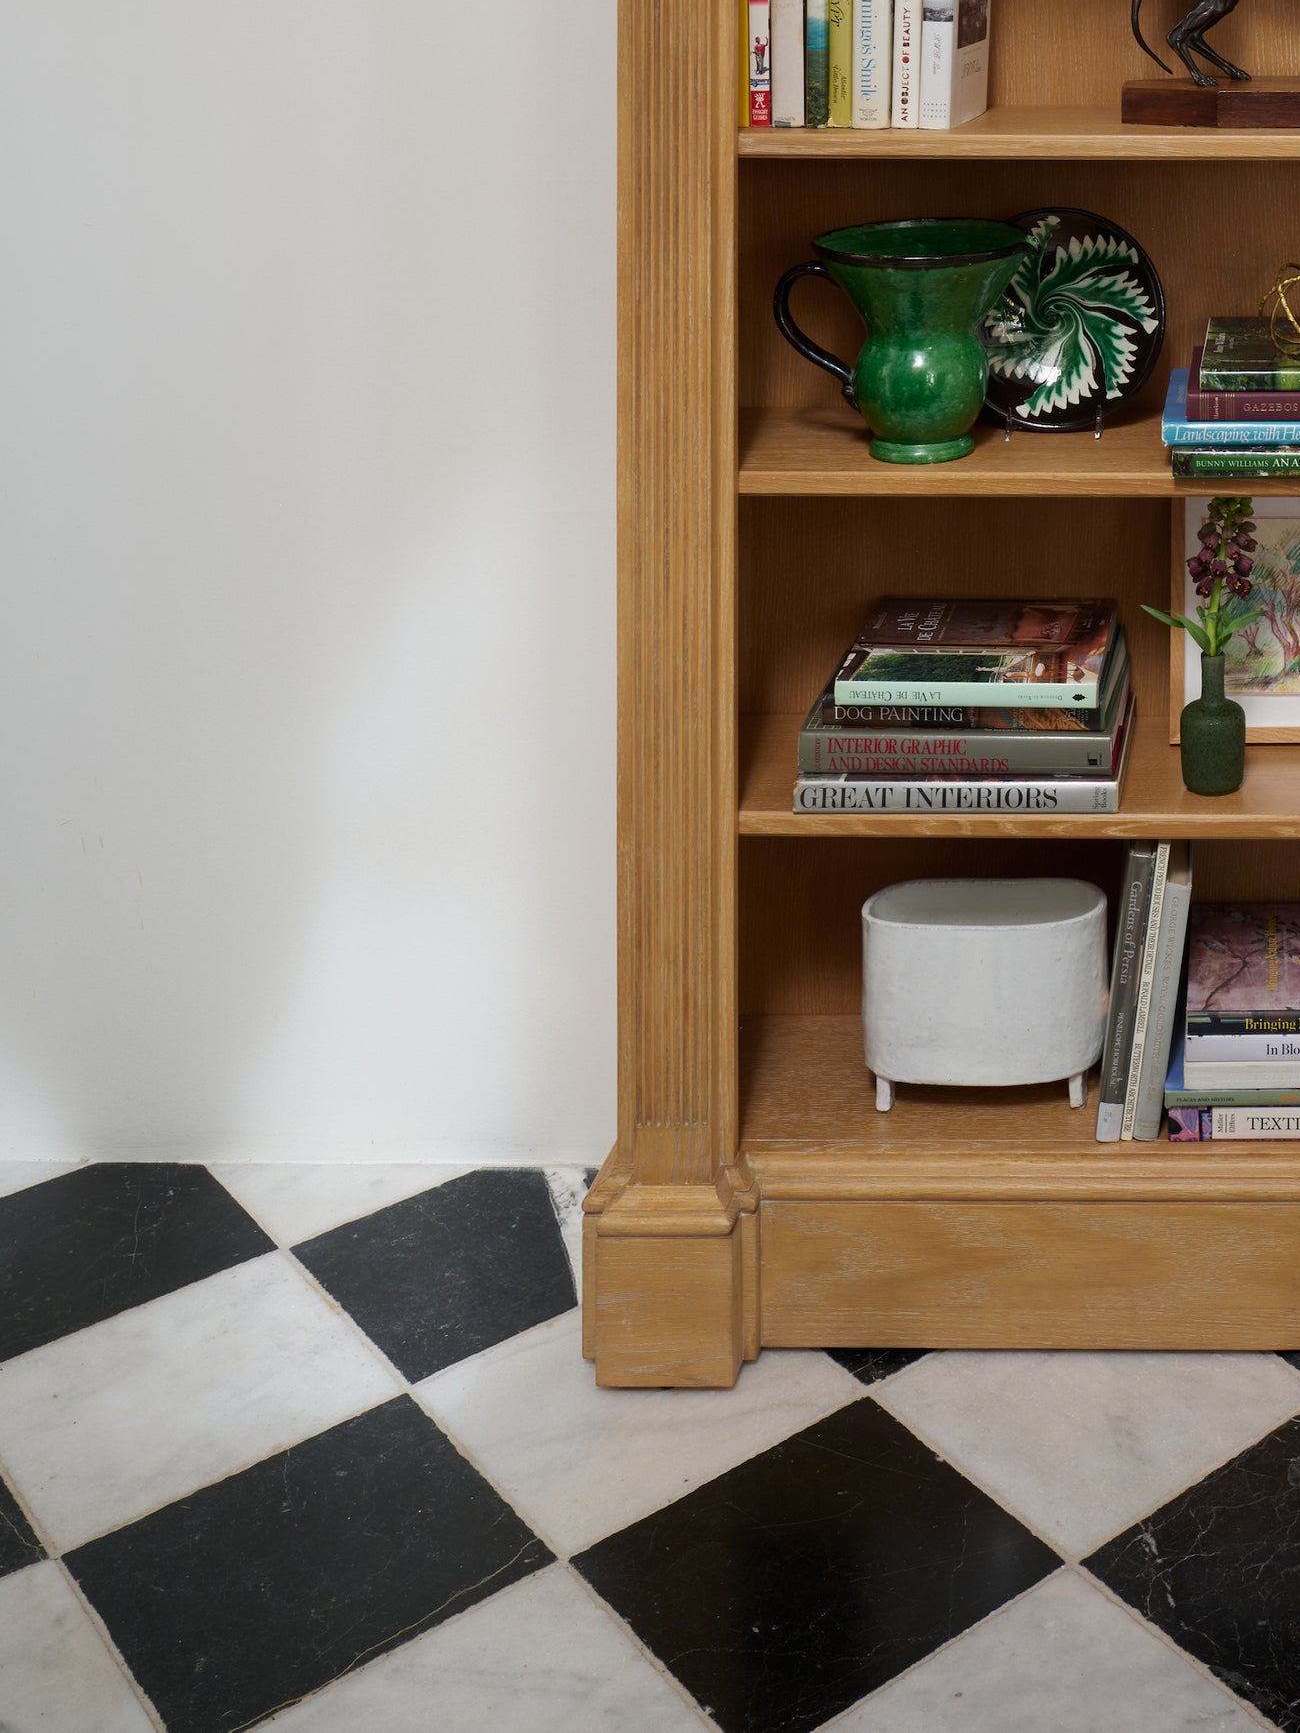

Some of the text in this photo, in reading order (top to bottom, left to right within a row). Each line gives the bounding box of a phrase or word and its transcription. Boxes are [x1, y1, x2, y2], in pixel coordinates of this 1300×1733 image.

[900, 7, 912, 123] AN OBJECT OF BEAUTY
[861, 59, 878, 101] Smile
[1243, 403, 1299, 412] GAZEBOS
[1174, 426, 1251, 444] Landscaping
[1253, 426, 1280, 441] with
[1272, 458, 1289, 467] AN
[896, 691, 909, 700] DE
[912, 690, 929, 702] VIE
[930, 691, 942, 700] LA
[833, 706, 963, 722] DOG PAINTING
[827, 737, 898, 755] INTERIOR
[901, 738, 967, 755] GRAPHIC
[828, 757, 1009, 773] AND DESIGN STANDARDS
[799, 786, 1058, 810] GREAT INTERIORS
[1119, 881, 1143, 985] Gardens of Persia
[1244, 1017, 1298, 1033] Bringing
[1266, 1043, 1279, 1056] In
